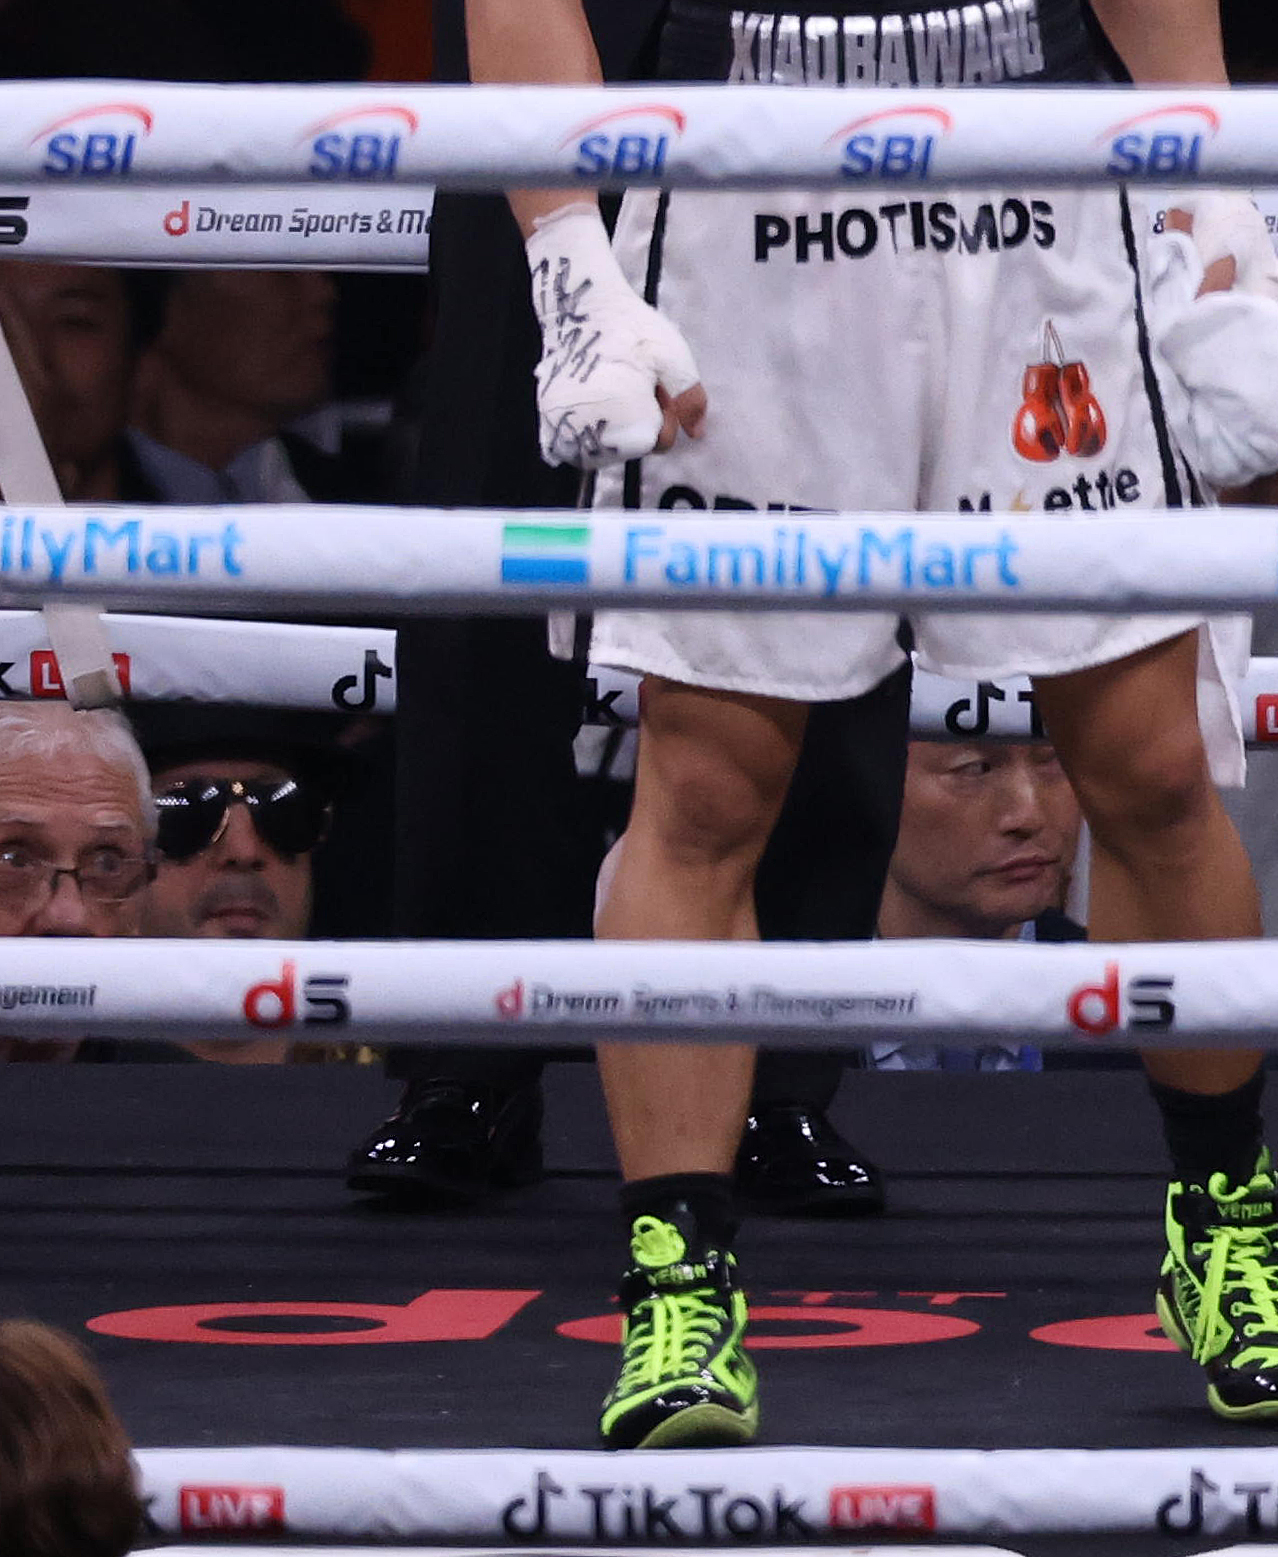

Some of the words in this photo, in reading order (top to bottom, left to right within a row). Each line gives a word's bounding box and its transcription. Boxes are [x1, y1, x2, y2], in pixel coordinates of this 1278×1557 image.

[42, 131, 138, 176] SBI
[310, 131, 402, 176] SBI
[576, 131, 670, 176] SBI
[841, 132, 937, 178] SBI
[1109, 130, 1204, 175] SBI
[196, 207, 280, 233] Dream
[289, 207, 373, 239] Sports
[377, 209, 392, 233] &
[753, 197, 1057, 263] PHOTISMOS
[621, 525, 1022, 598] FamilyMart
[581, 1483, 817, 1540] TikTok
